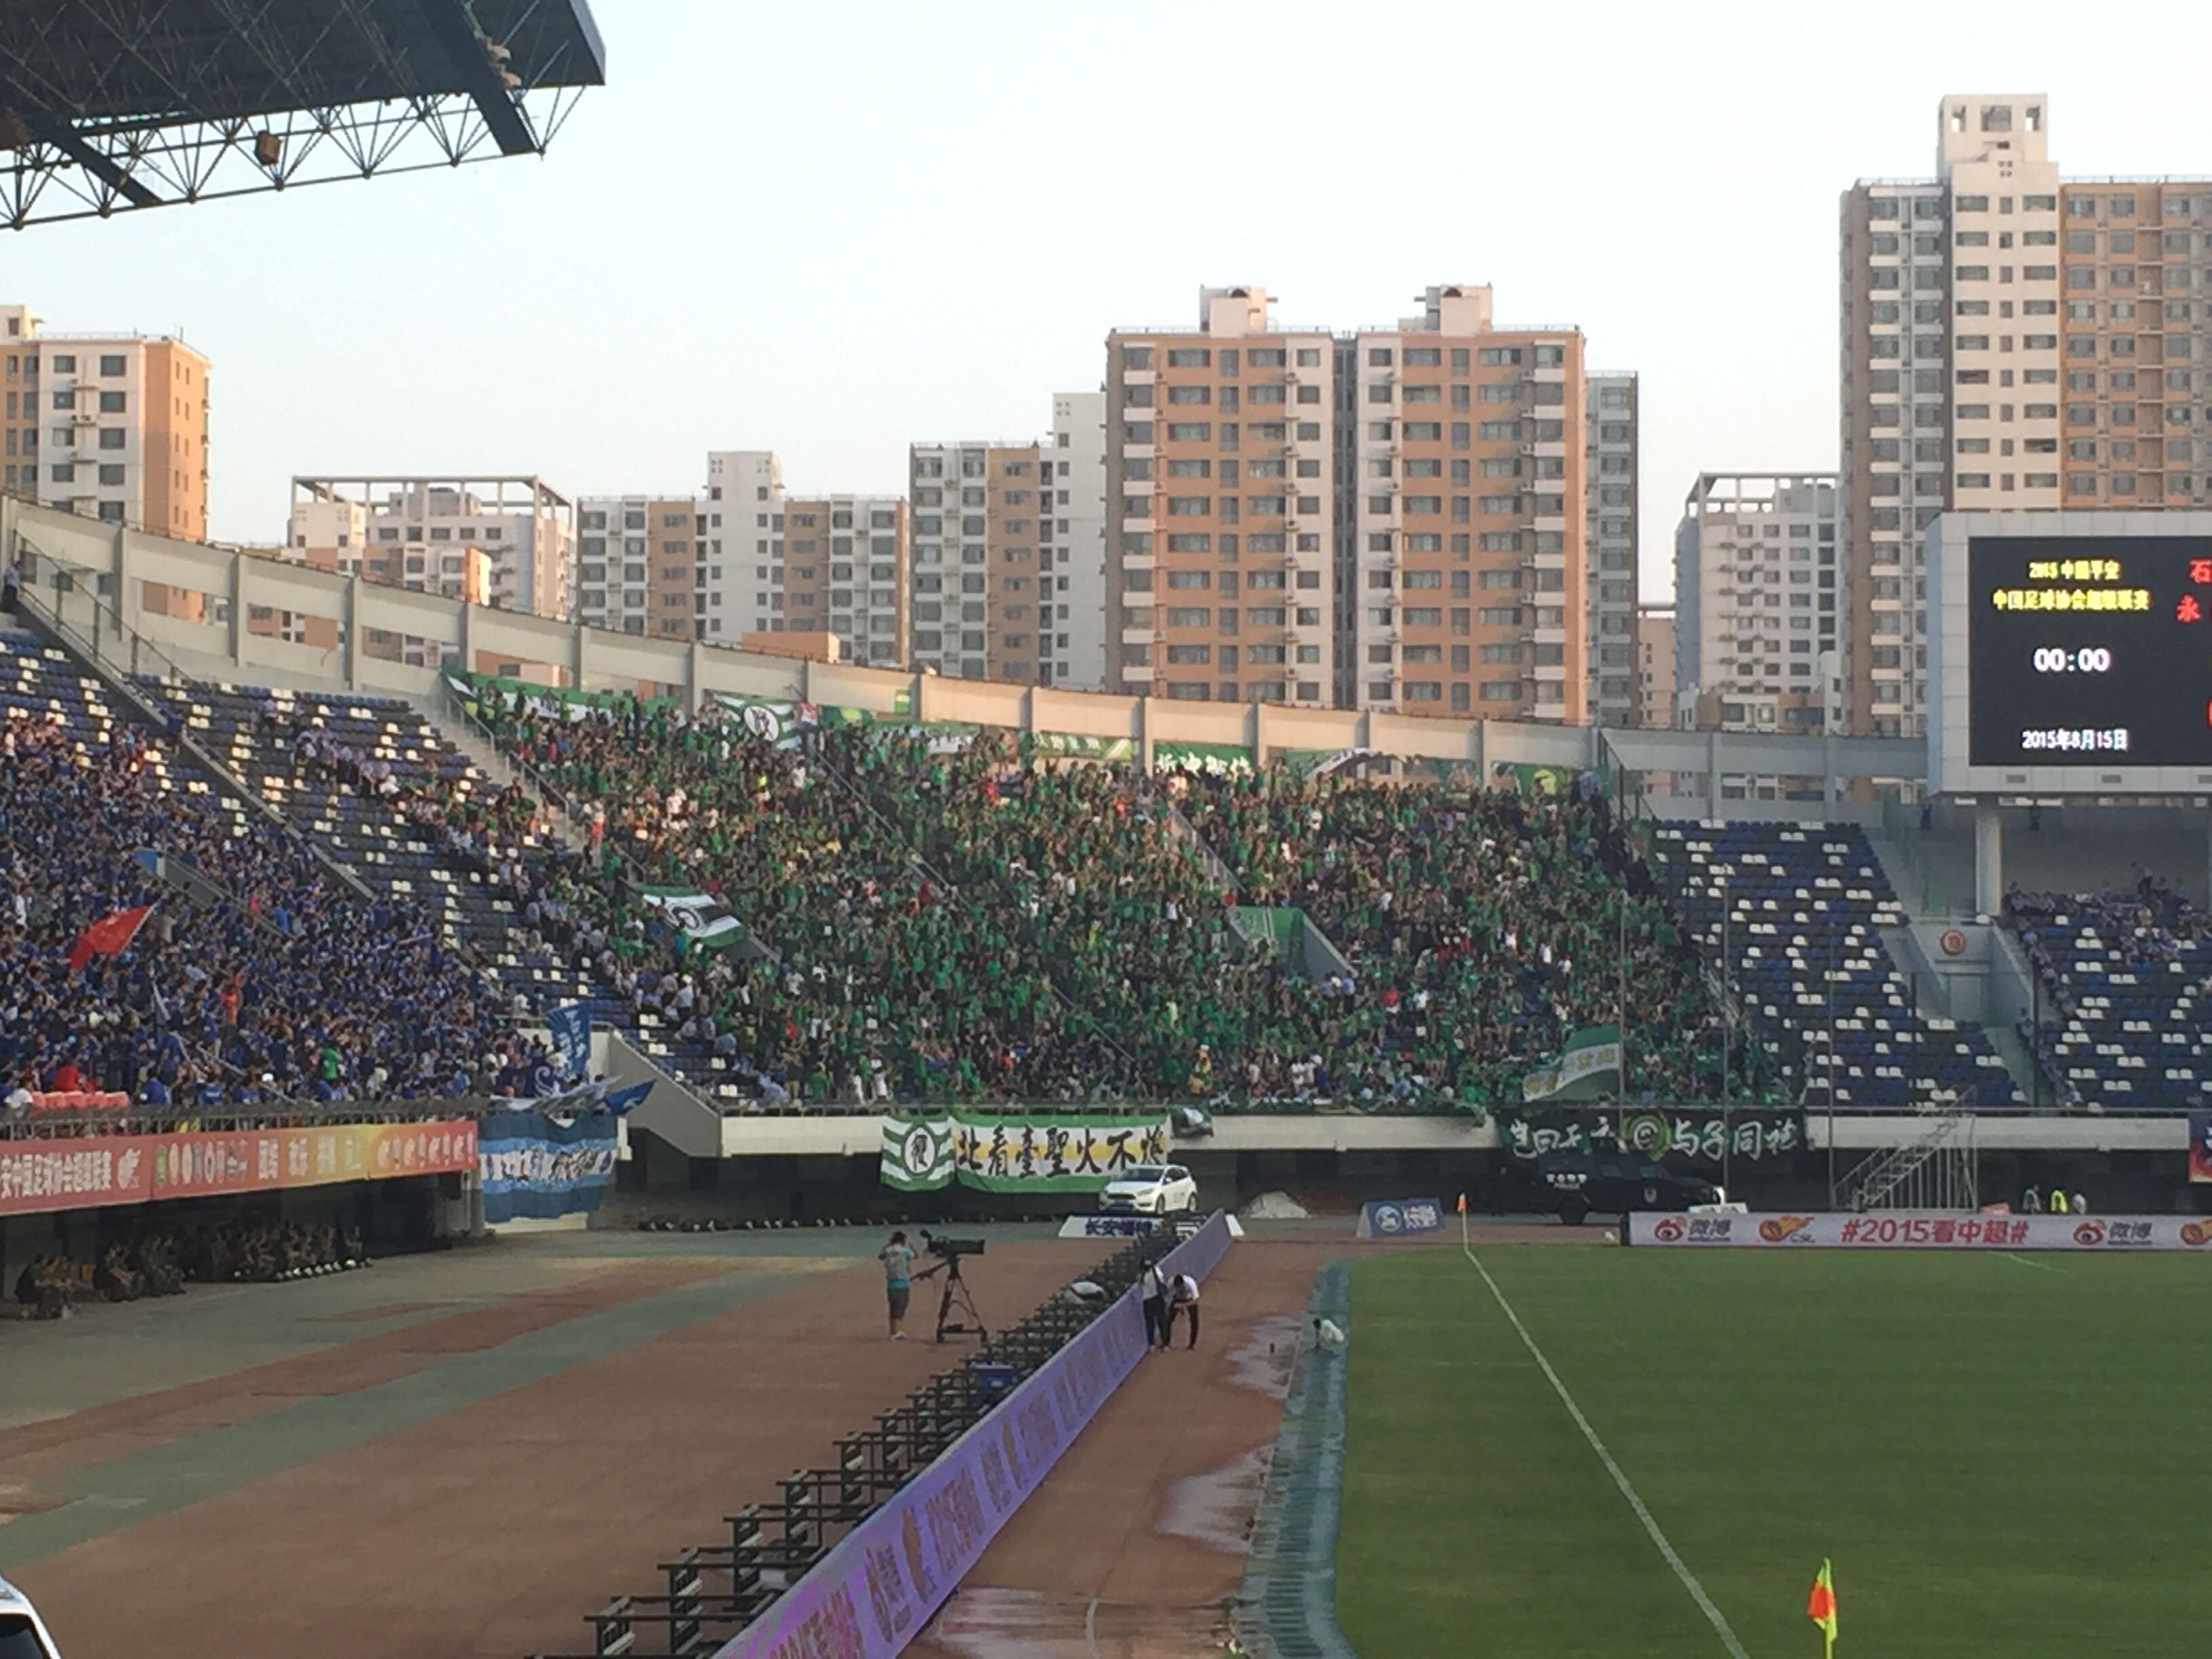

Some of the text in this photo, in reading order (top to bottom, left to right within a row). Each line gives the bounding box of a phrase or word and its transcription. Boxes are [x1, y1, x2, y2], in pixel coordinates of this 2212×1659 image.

[2034, 648, 2111, 672] 00:00
[2022, 729, 2128, 750] 2015年8月15日
[1840, 1219, 2030, 1244] #2015看中超#
[2109, 1223, 2153, 1240] 微博
